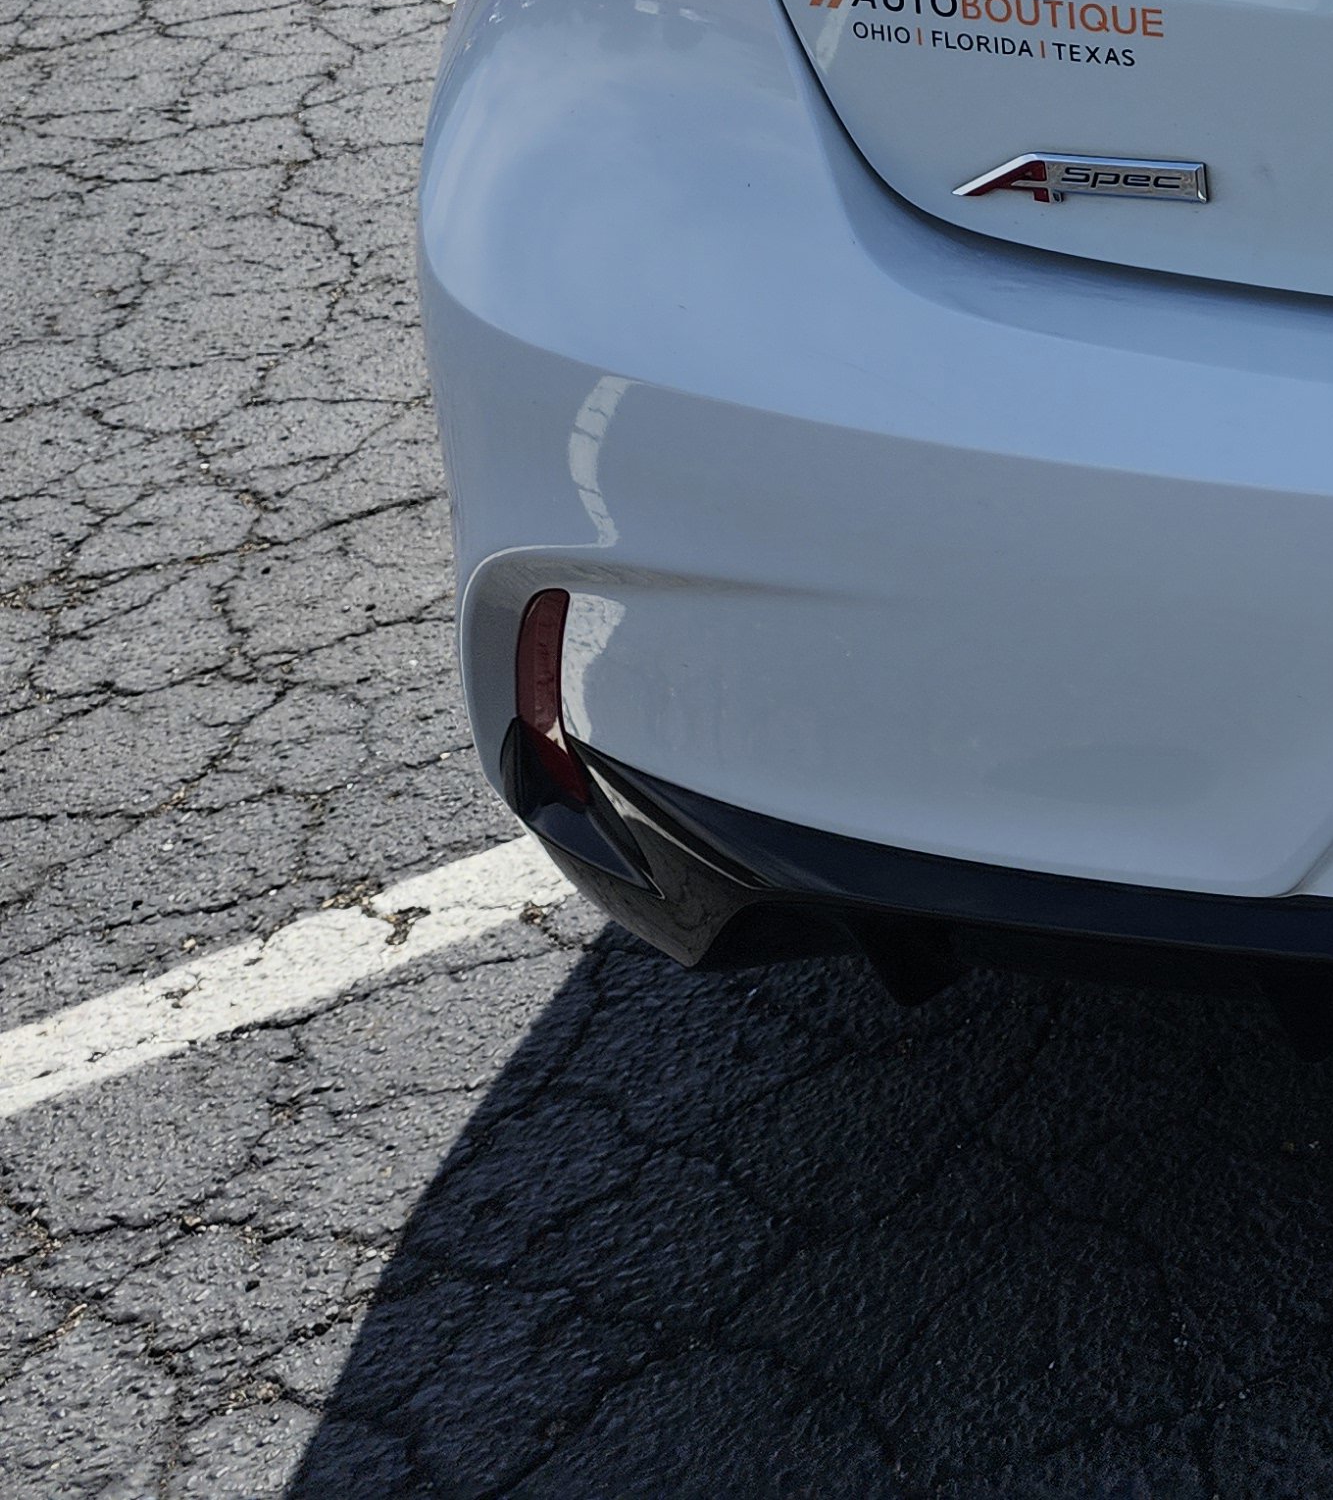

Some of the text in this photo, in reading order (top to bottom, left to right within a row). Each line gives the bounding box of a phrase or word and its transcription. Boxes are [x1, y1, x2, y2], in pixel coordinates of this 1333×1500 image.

[852, 21, 1137, 68] OHIO FLORIDA TEXAS
